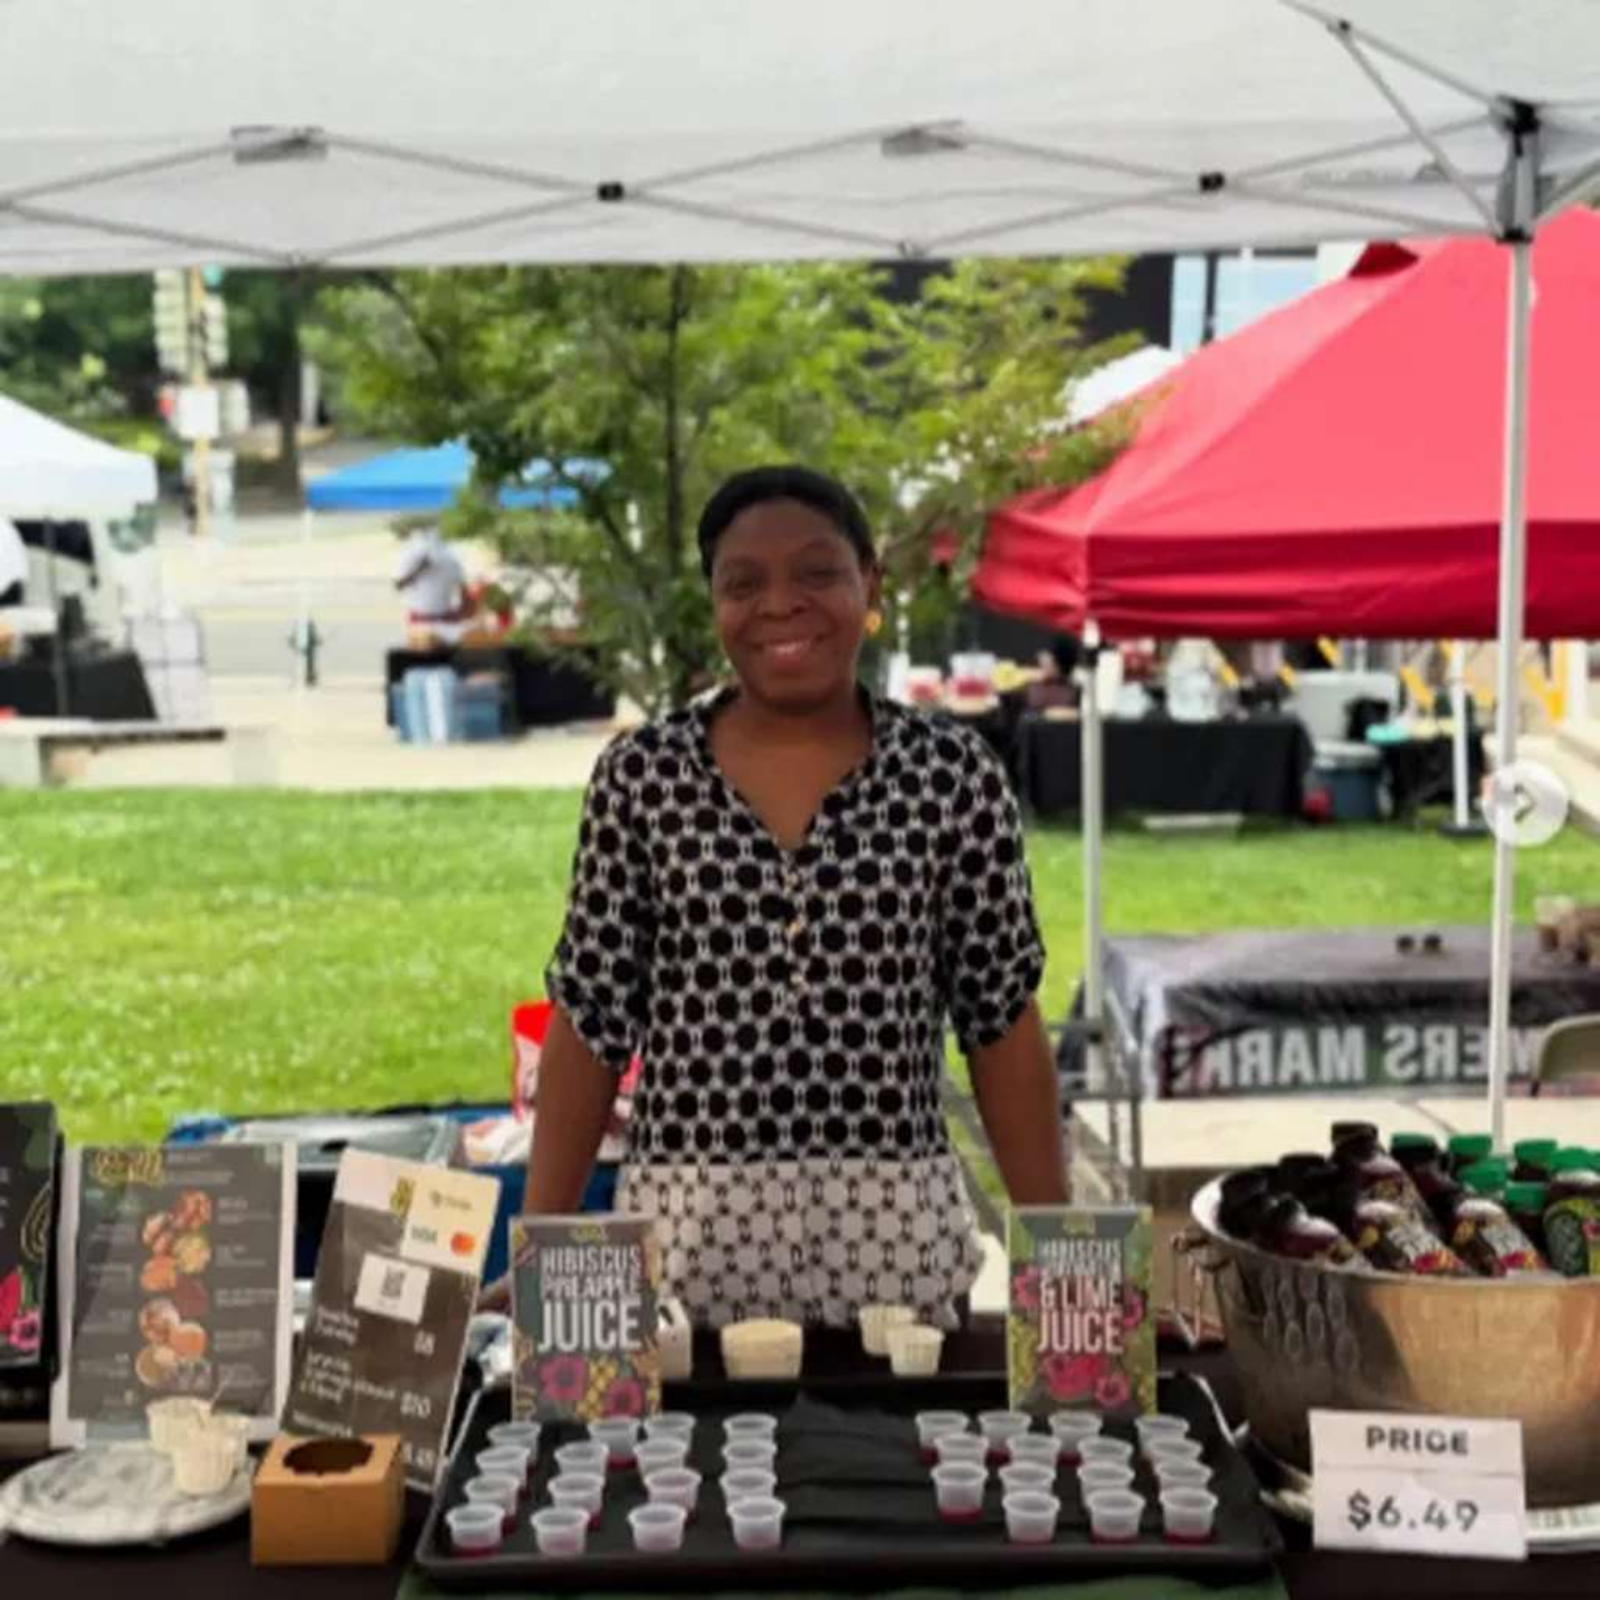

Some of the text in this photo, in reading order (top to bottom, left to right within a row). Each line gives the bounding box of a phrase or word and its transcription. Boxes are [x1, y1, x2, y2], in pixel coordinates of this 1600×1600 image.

[540, 1244, 642, 1274] HIBISCUS
[1062, 1275, 1124, 1309] LIME
[538, 1299, 643, 1351] JUICE
[1037, 1309, 1125, 1354] JUICE
[1366, 1426, 1469, 1456] PRICE
[1347, 1488, 1480, 1531] $6.49
